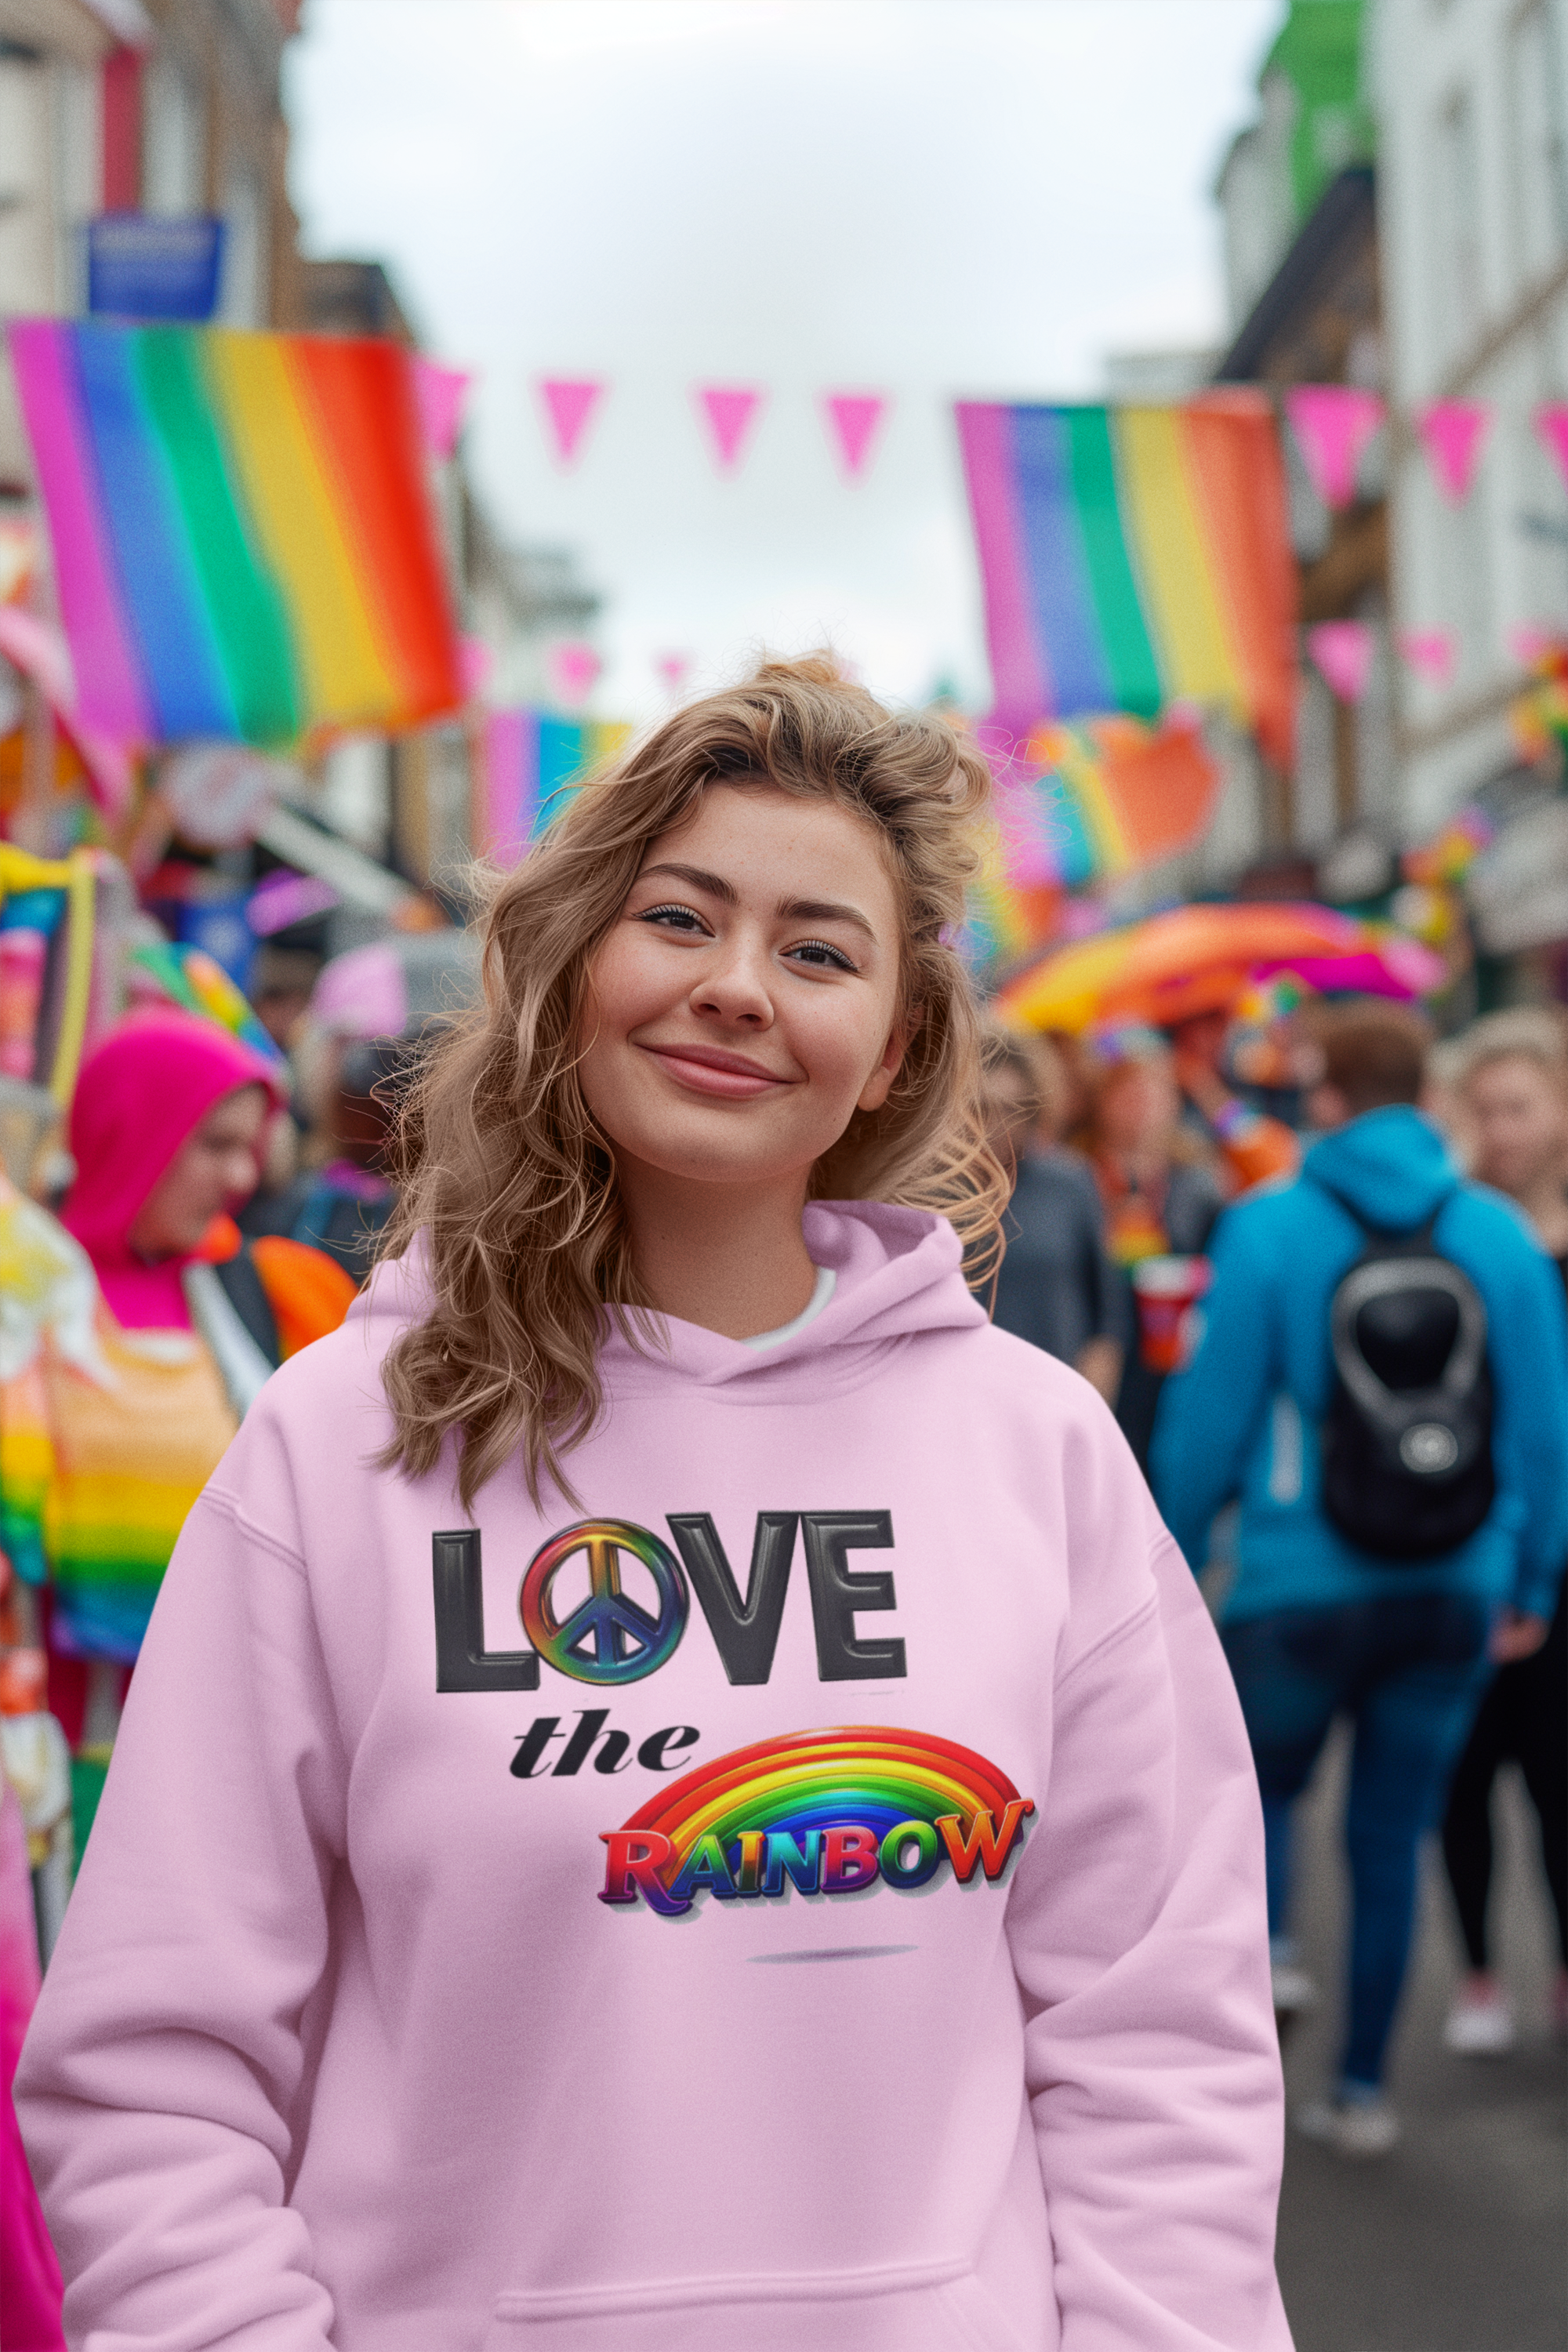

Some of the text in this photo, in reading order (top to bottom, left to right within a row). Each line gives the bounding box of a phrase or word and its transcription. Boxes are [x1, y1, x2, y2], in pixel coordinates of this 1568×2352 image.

[431, 1509, 907, 1693] LOVE
[509, 1708, 700, 1779] the
[597, 1799, 1035, 1917] RAINBOW
